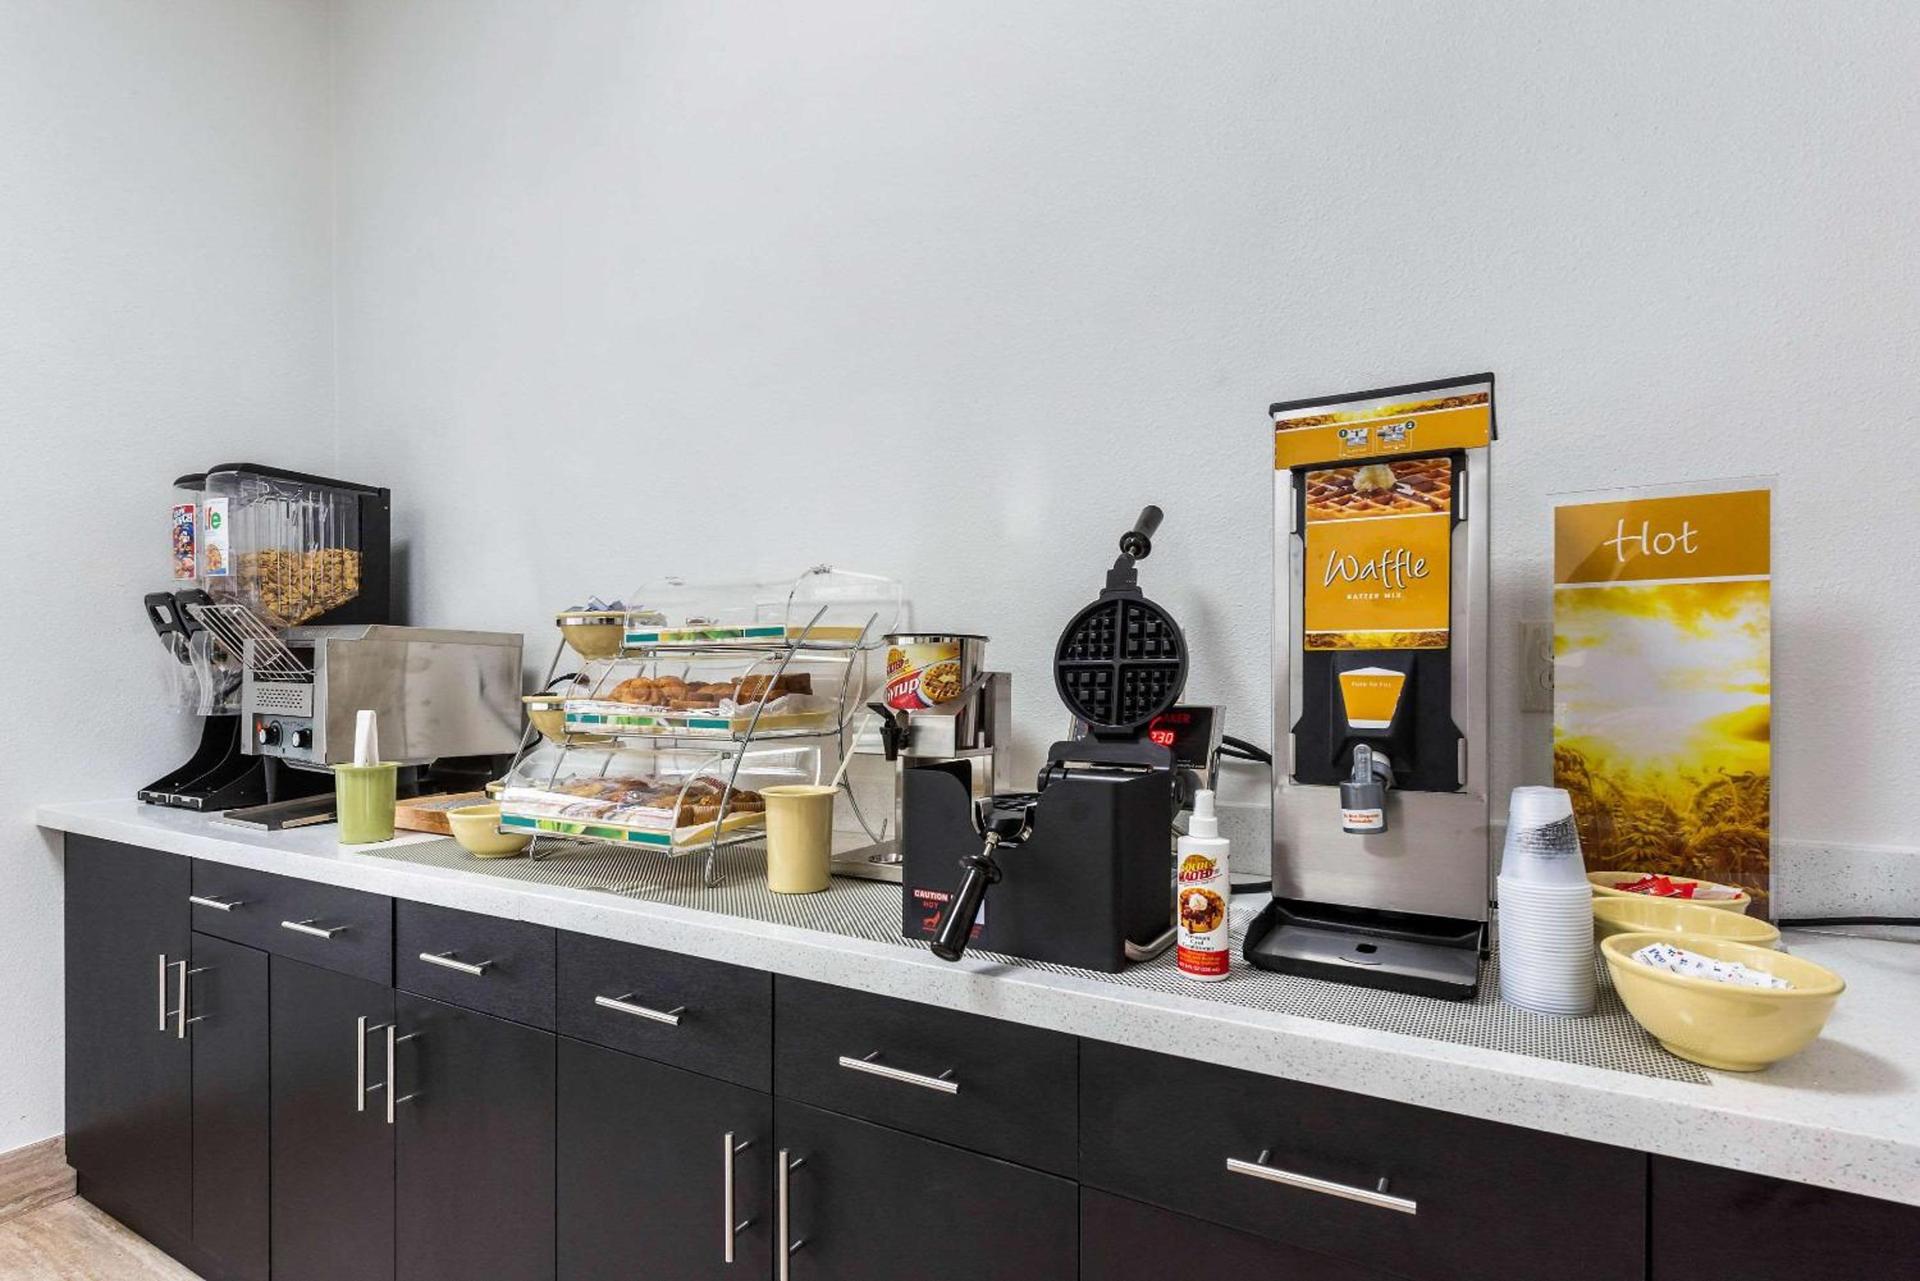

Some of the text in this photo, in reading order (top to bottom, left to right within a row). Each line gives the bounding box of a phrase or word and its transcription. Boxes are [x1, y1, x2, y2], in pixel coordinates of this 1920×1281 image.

[1603, 518, 1699, 562] Hot
[1324, 548, 1430, 589] Waffle
[914, 889, 949, 901] CAUTION
